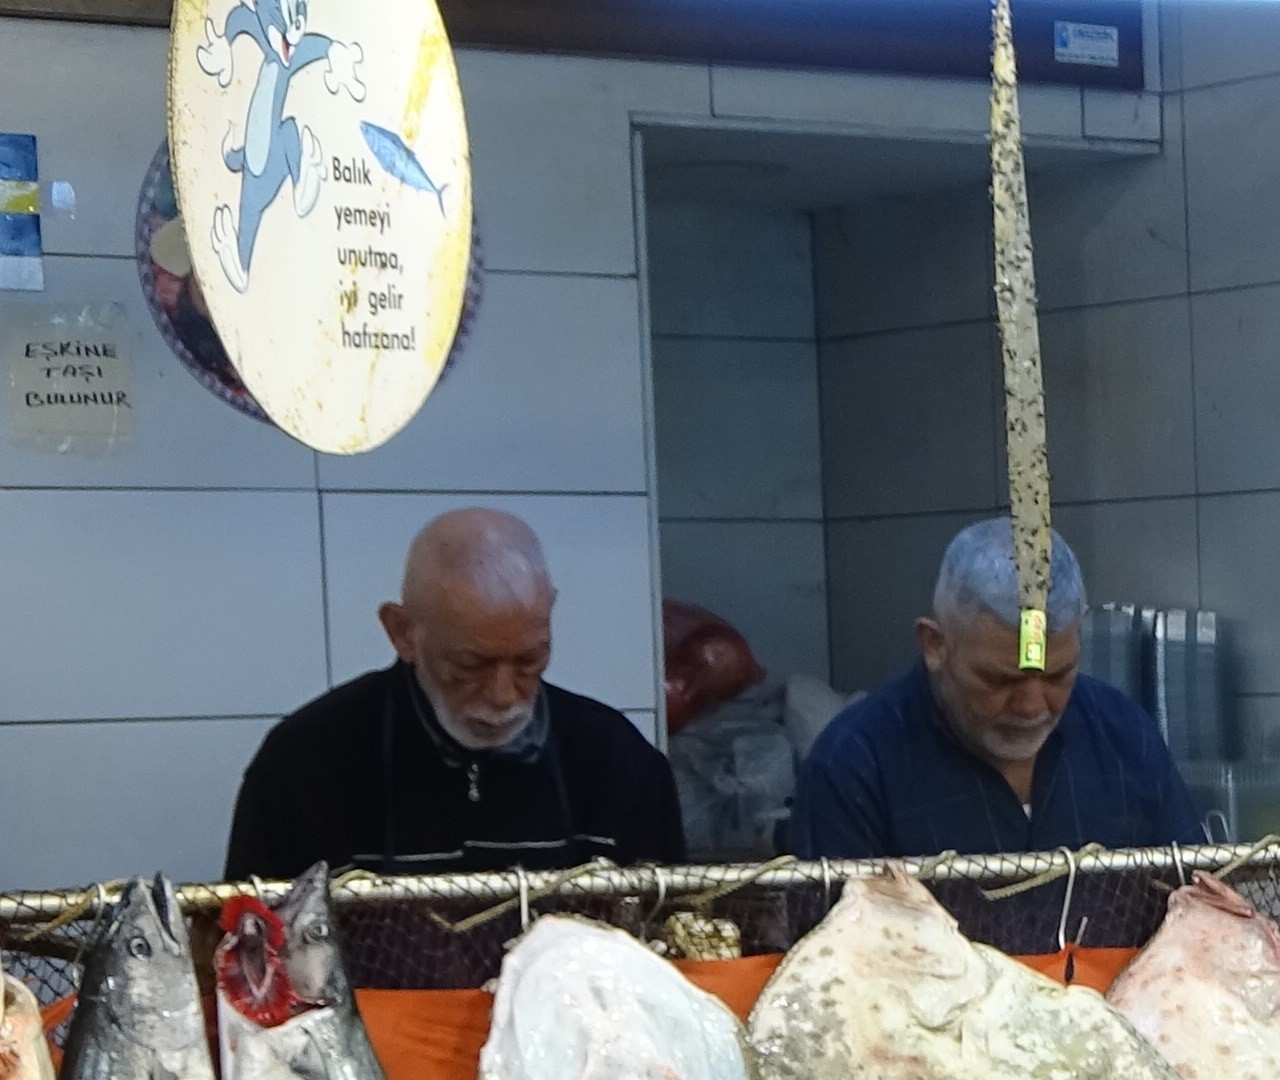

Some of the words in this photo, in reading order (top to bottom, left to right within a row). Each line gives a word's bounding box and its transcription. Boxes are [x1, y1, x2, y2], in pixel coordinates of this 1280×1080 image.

[332, 156, 372, 186] Balık
[334, 202, 391, 235] yemeyi
[337, 246, 403, 274] unutma,
[368, 283, 403, 316] gelir
[341, 316, 416, 351] hafızana!
